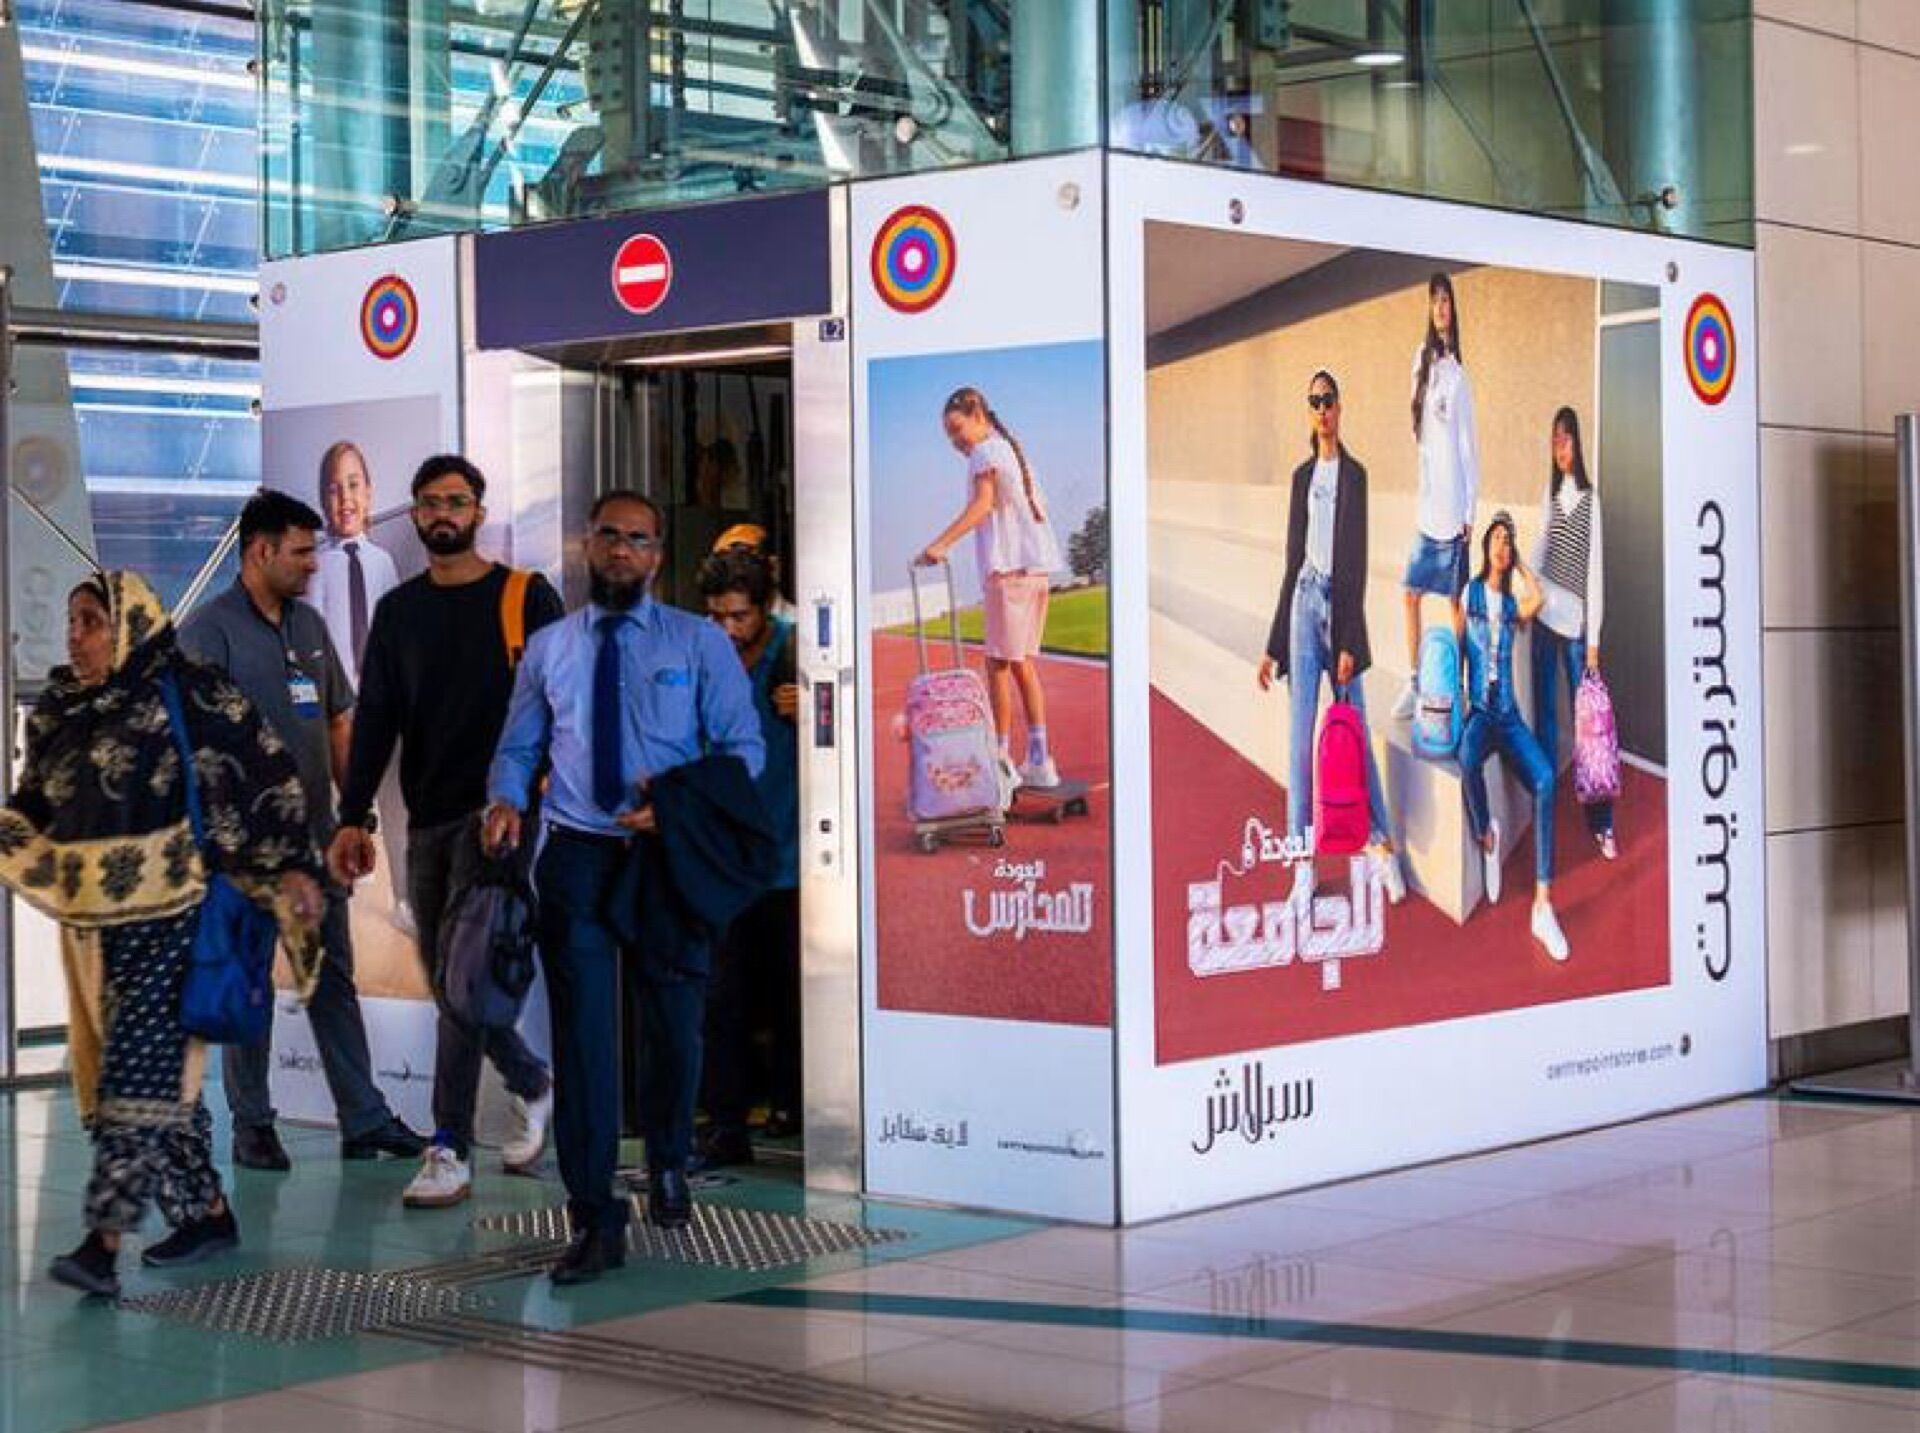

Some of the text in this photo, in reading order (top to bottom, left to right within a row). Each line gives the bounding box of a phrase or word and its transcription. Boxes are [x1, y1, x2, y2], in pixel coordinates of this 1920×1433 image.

[1693, 500, 1736, 982] سنتربوينت
[963, 881, 1093, 940] للمدارس
[993, 858, 1044, 882] العودة
[1187, 857, 1385, 990] للجامعة
[1192, 1061, 1314, 1154] سبلاش
